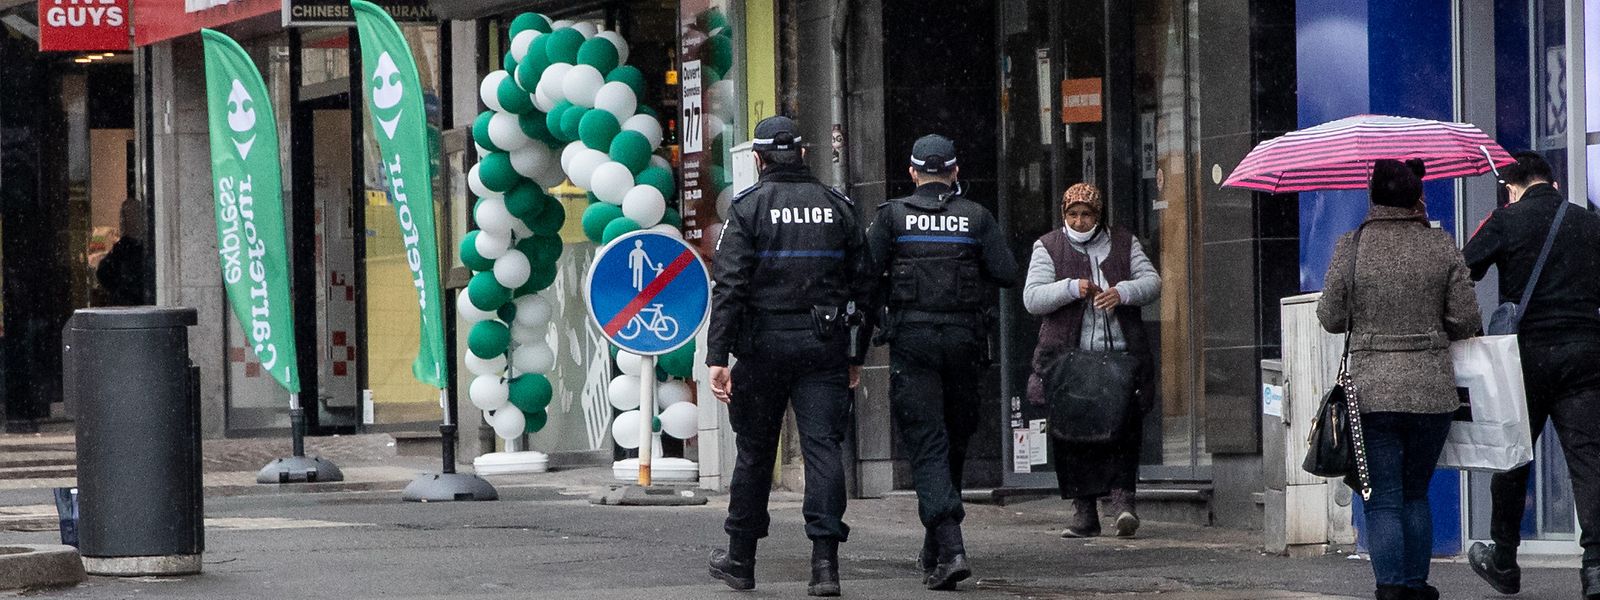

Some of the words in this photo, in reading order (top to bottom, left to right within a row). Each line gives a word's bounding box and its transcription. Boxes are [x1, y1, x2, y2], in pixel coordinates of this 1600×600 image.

[47, 6, 123, 27] GUYS
[292, 5, 348, 18] CHINESE
[685, 102, 700, 147] 7/7
[770, 207, 834, 224] POLICE
[905, 214, 969, 232] POLICE
